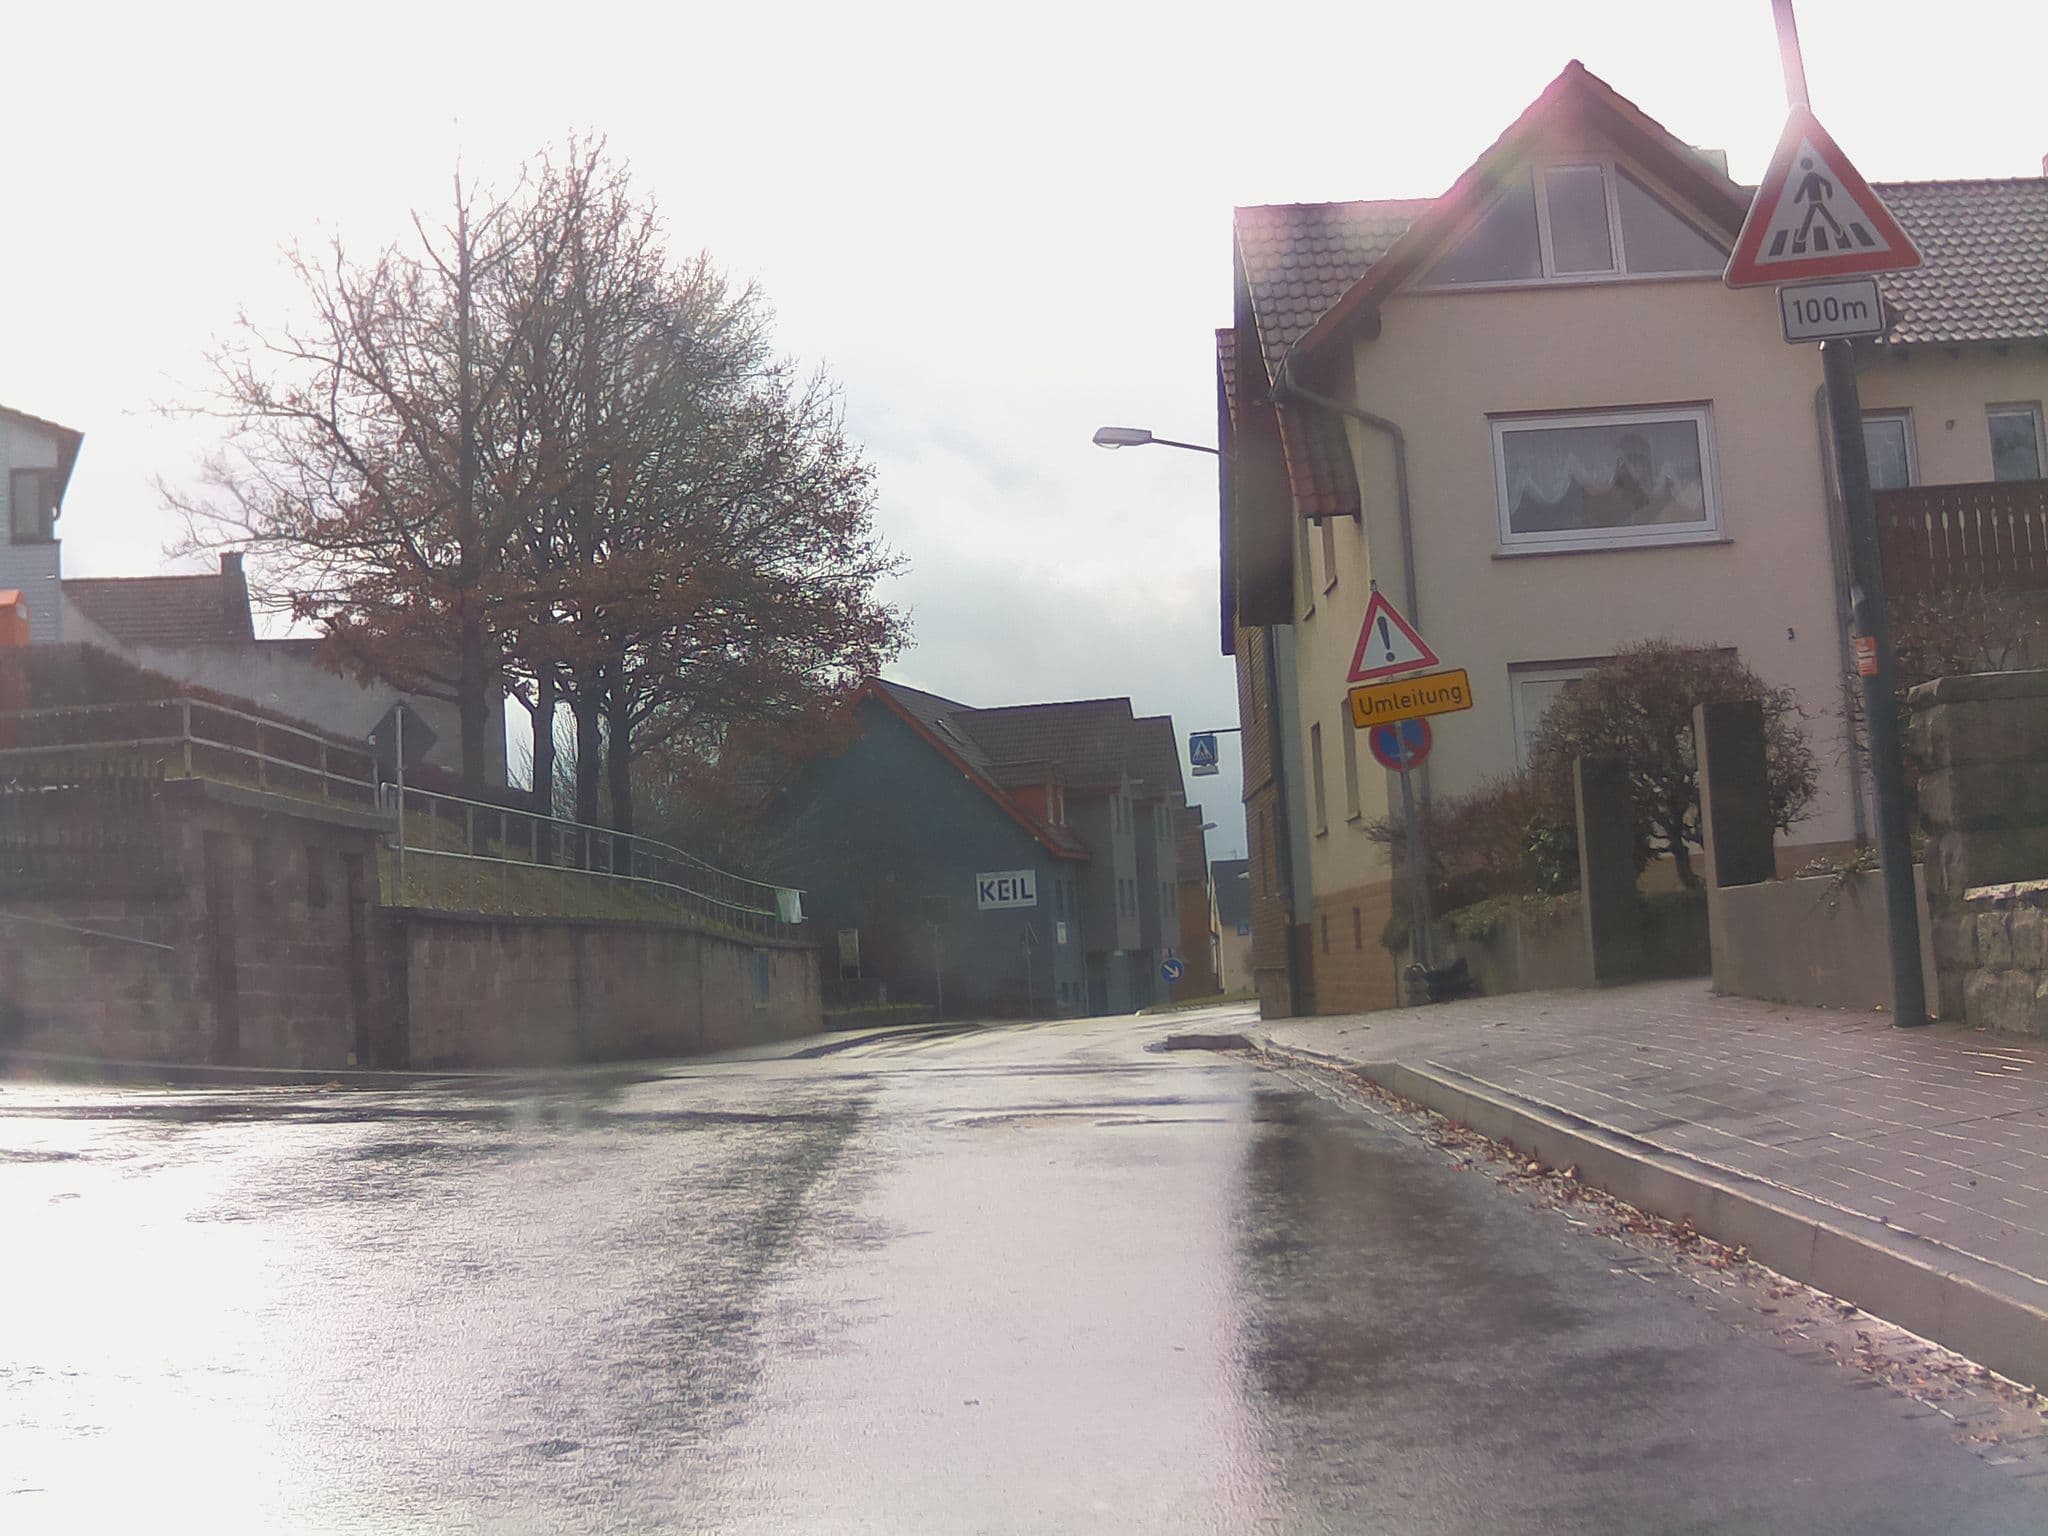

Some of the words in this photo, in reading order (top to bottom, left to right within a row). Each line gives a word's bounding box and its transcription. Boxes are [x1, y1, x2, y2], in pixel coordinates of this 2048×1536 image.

[1793, 297, 1866, 324] 100m
[1359, 686, 1462, 715] Umleitung
[980, 878, 1033, 902] KEIL
